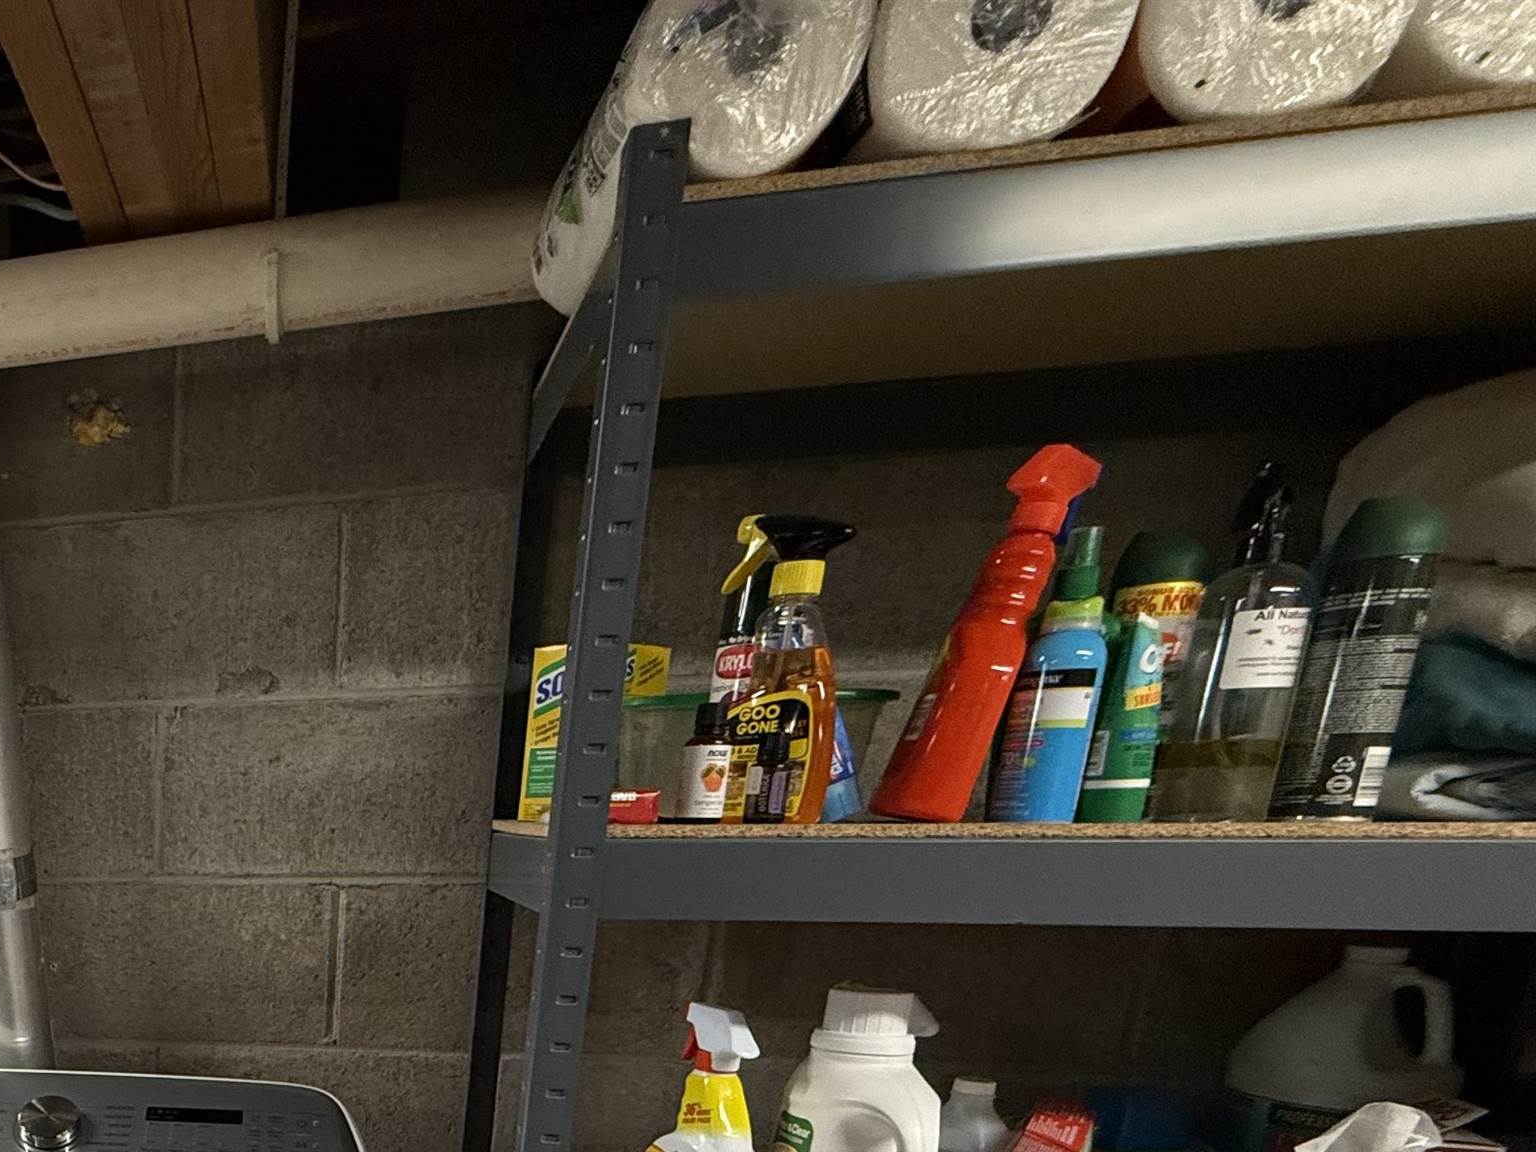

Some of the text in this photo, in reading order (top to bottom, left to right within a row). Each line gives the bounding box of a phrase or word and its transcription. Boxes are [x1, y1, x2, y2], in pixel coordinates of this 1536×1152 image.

[1255, 609, 1275, 621] All
[739, 704, 781, 721] GOO
[736, 719, 779, 735] GONE
